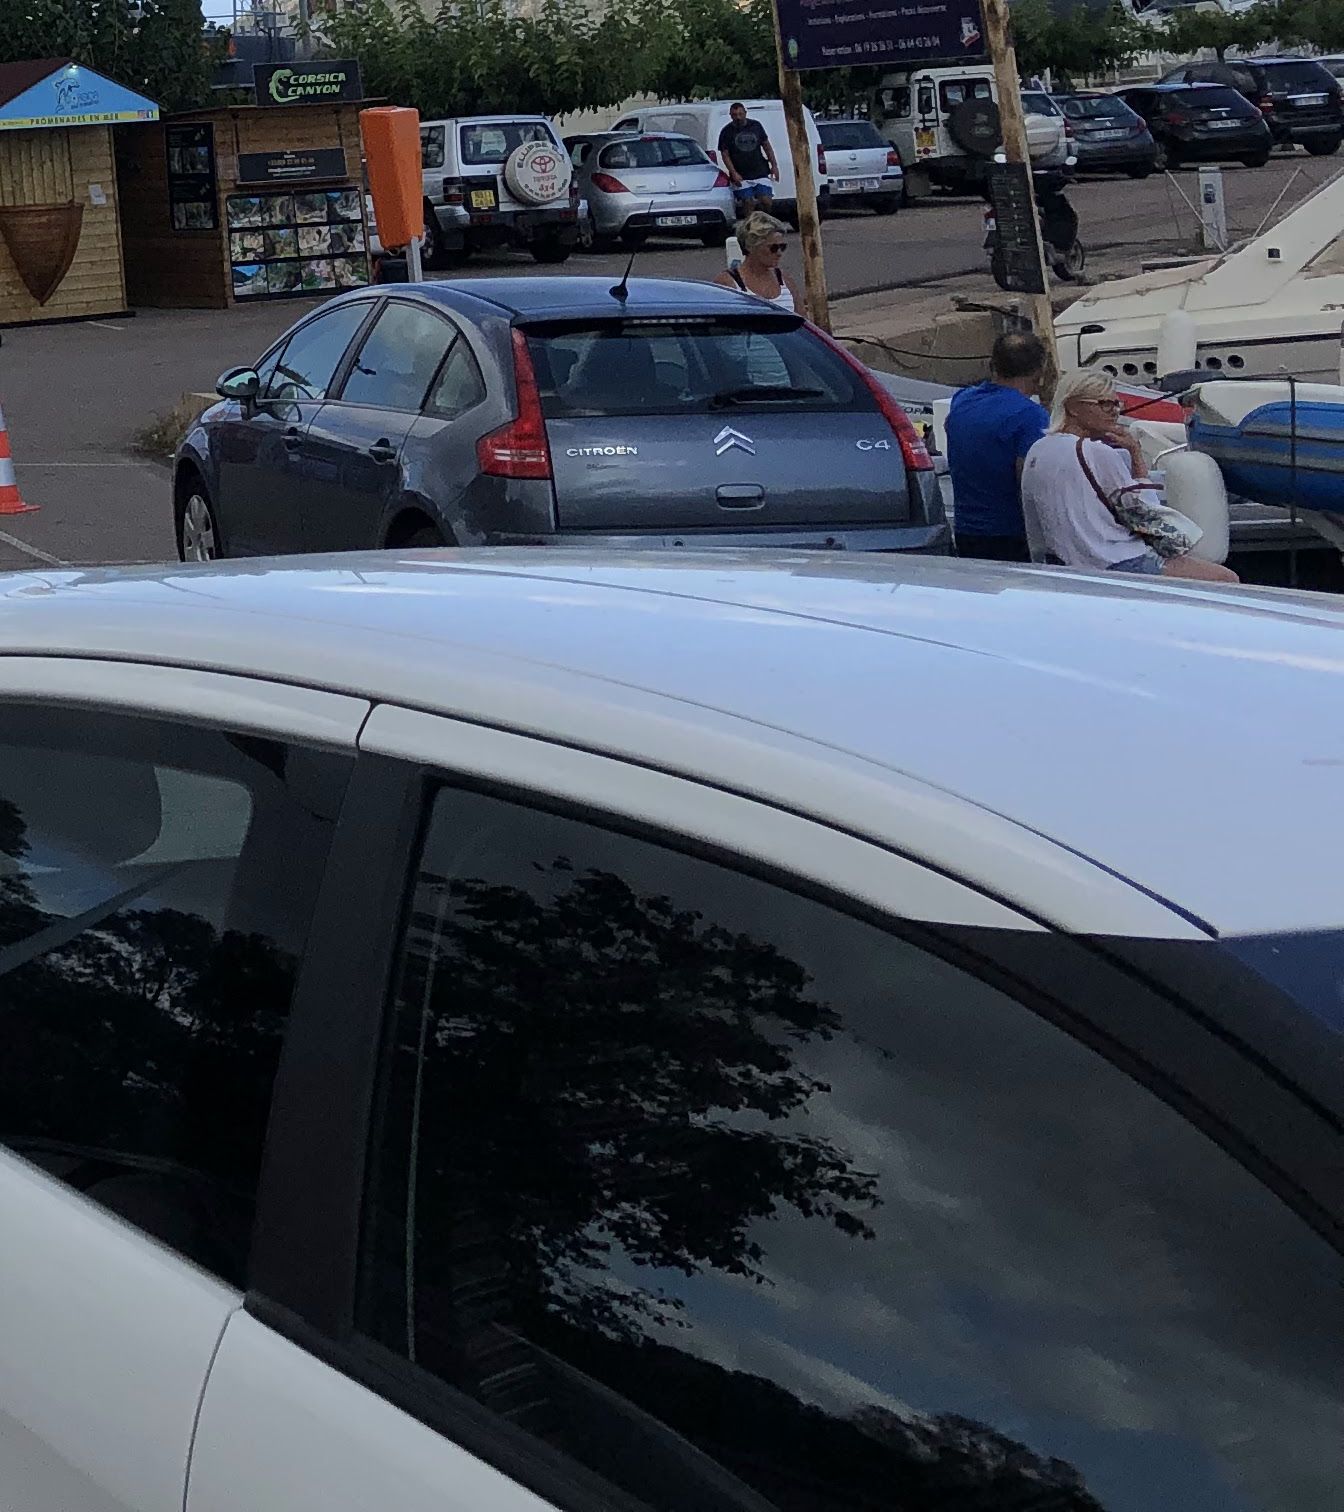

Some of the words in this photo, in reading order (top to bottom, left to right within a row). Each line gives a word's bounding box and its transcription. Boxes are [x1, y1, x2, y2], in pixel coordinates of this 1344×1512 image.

[289, 72, 346, 85] CORSICA
[287, 84, 341, 96] CANYON
[30, 115, 86, 126] PROMENADES
[532, 174, 558, 183] TOYOTA
[538, 182, 556, 193] 4x4
[855, 438, 891, 451] C4
[566, 445, 638, 457] CITROËN
